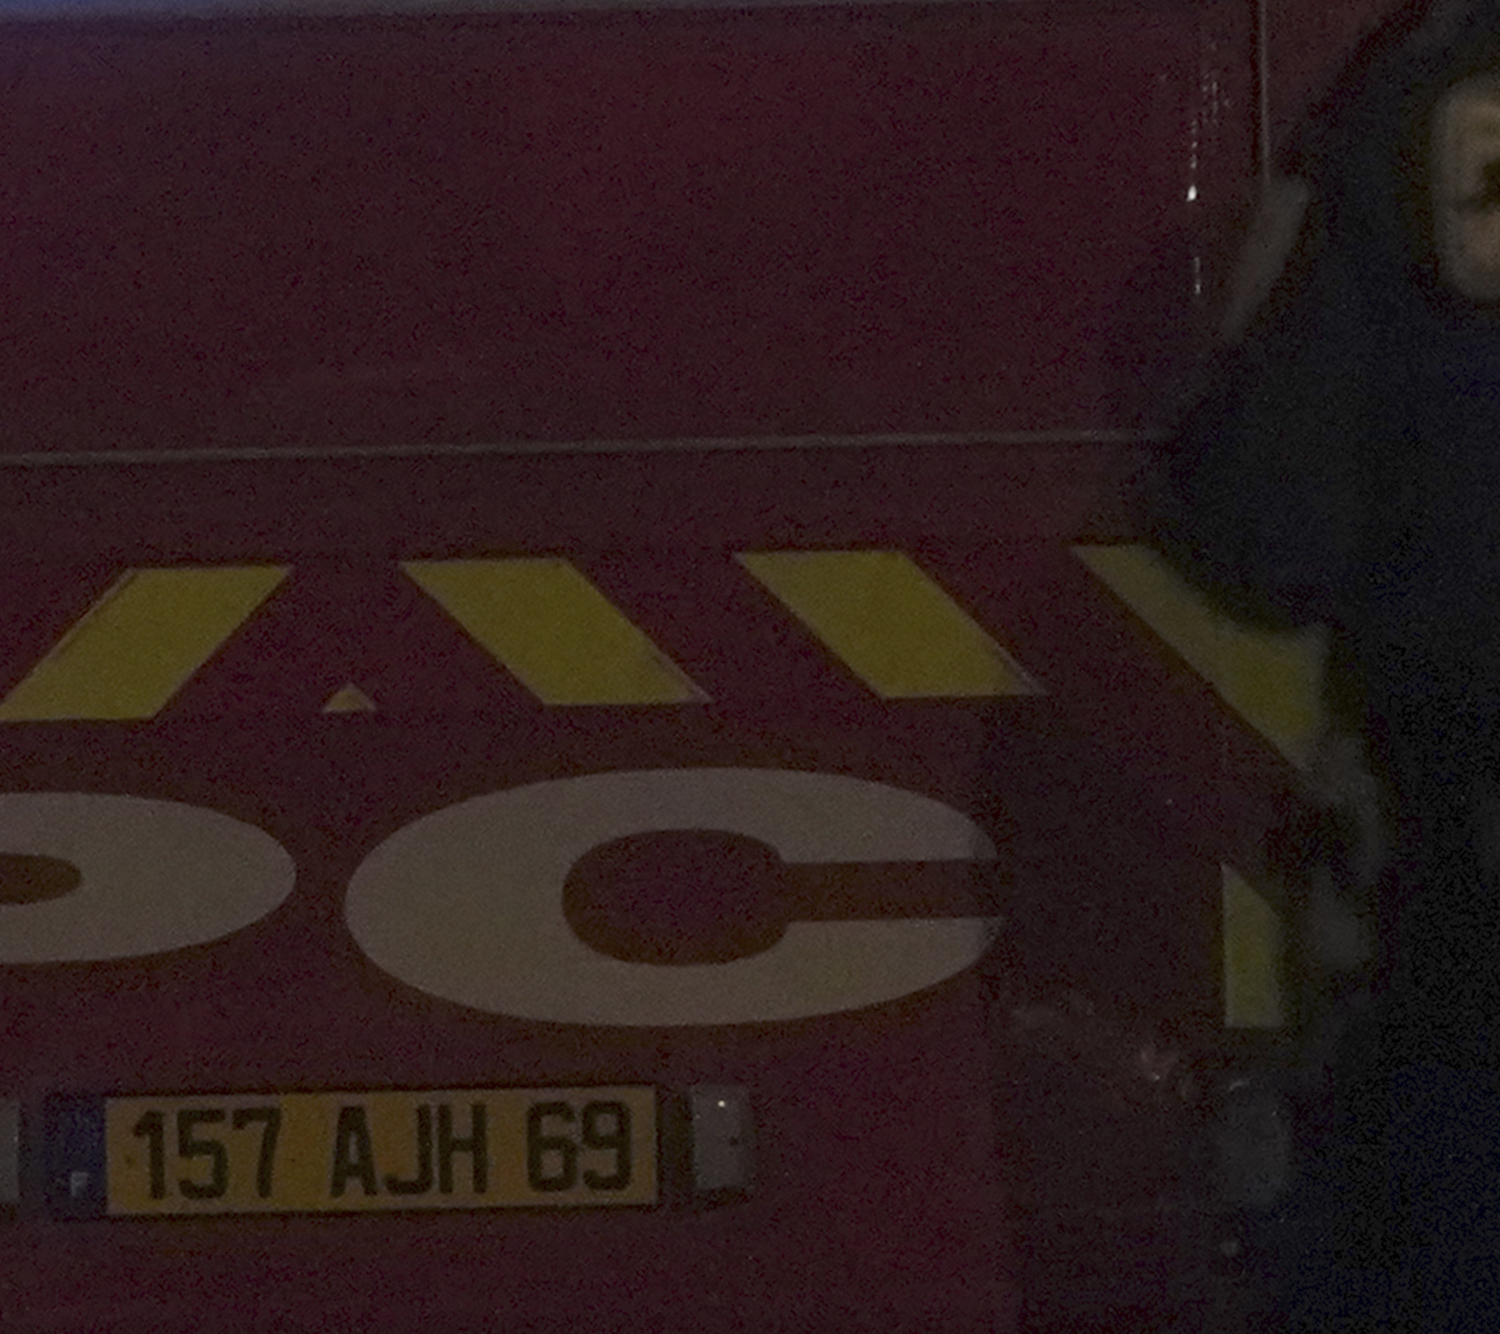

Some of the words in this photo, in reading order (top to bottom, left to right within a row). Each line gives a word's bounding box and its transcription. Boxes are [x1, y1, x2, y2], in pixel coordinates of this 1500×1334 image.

[133, 1107, 282, 1199] 157
[330, 1103, 488, 1197] AJH
[525, 1101, 632, 1193] 69
